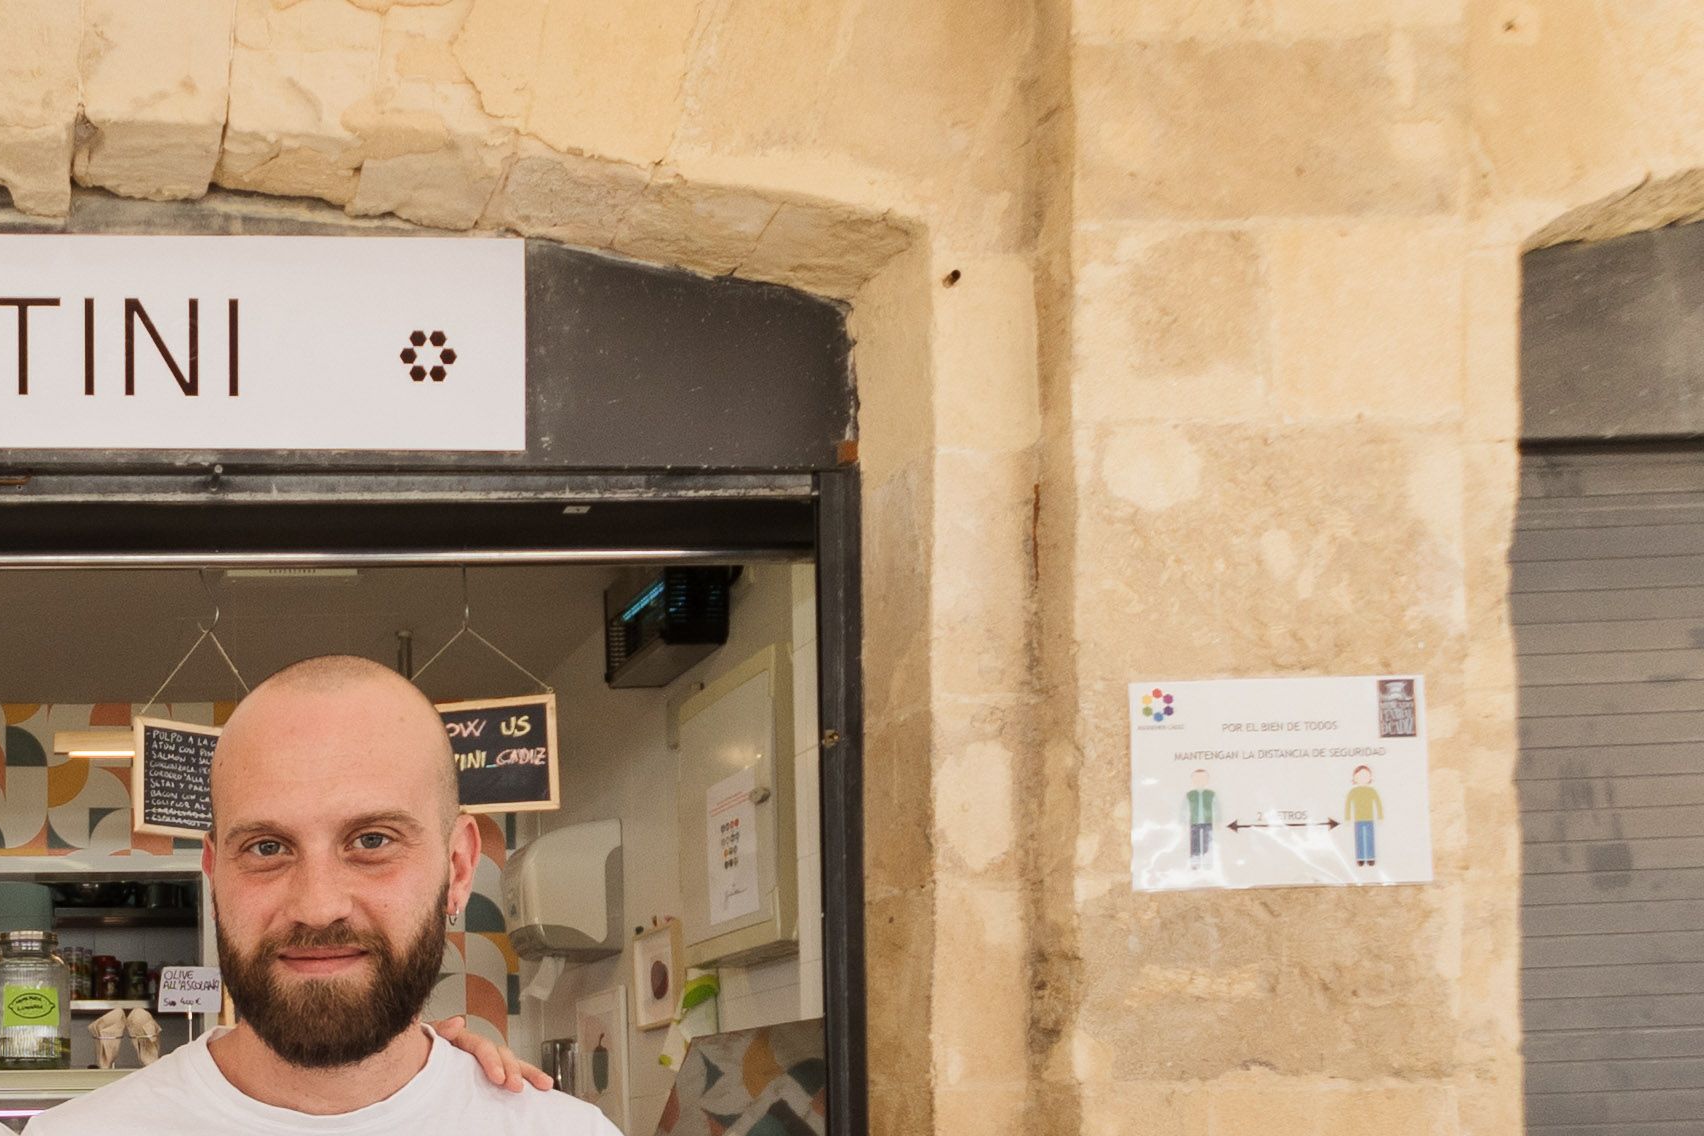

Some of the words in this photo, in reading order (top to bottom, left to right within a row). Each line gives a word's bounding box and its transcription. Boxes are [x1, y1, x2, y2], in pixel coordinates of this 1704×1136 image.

[446, 718, 487, 738] OW
[500, 714, 532, 738] US
[1221, 722, 1242, 732] POR
[1246, 722, 1257, 732] EL
[1260, 721, 1283, 732] BIEN
[1286, 721, 1301, 732] DE
[1304, 720, 1337, 731] TODOS
[152, 730, 183, 743] PULPO
[188, 736, 194, 744] A
[197, 738, 208, 747] LA
[179, 746, 196, 754] CON
[1174, 750, 1239, 761] MANTENGAN
[1242, 749, 1255, 760] LA
[1257, 748, 1310, 760] DISTANCIA
[1312, 747, 1326, 758] DE
[1329, 746, 1386, 758] SEGURIDAD
[150, 789, 178, 799] BACON
[181, 792, 196, 801] CON
[163, 970, 195, 981] OLIVE
